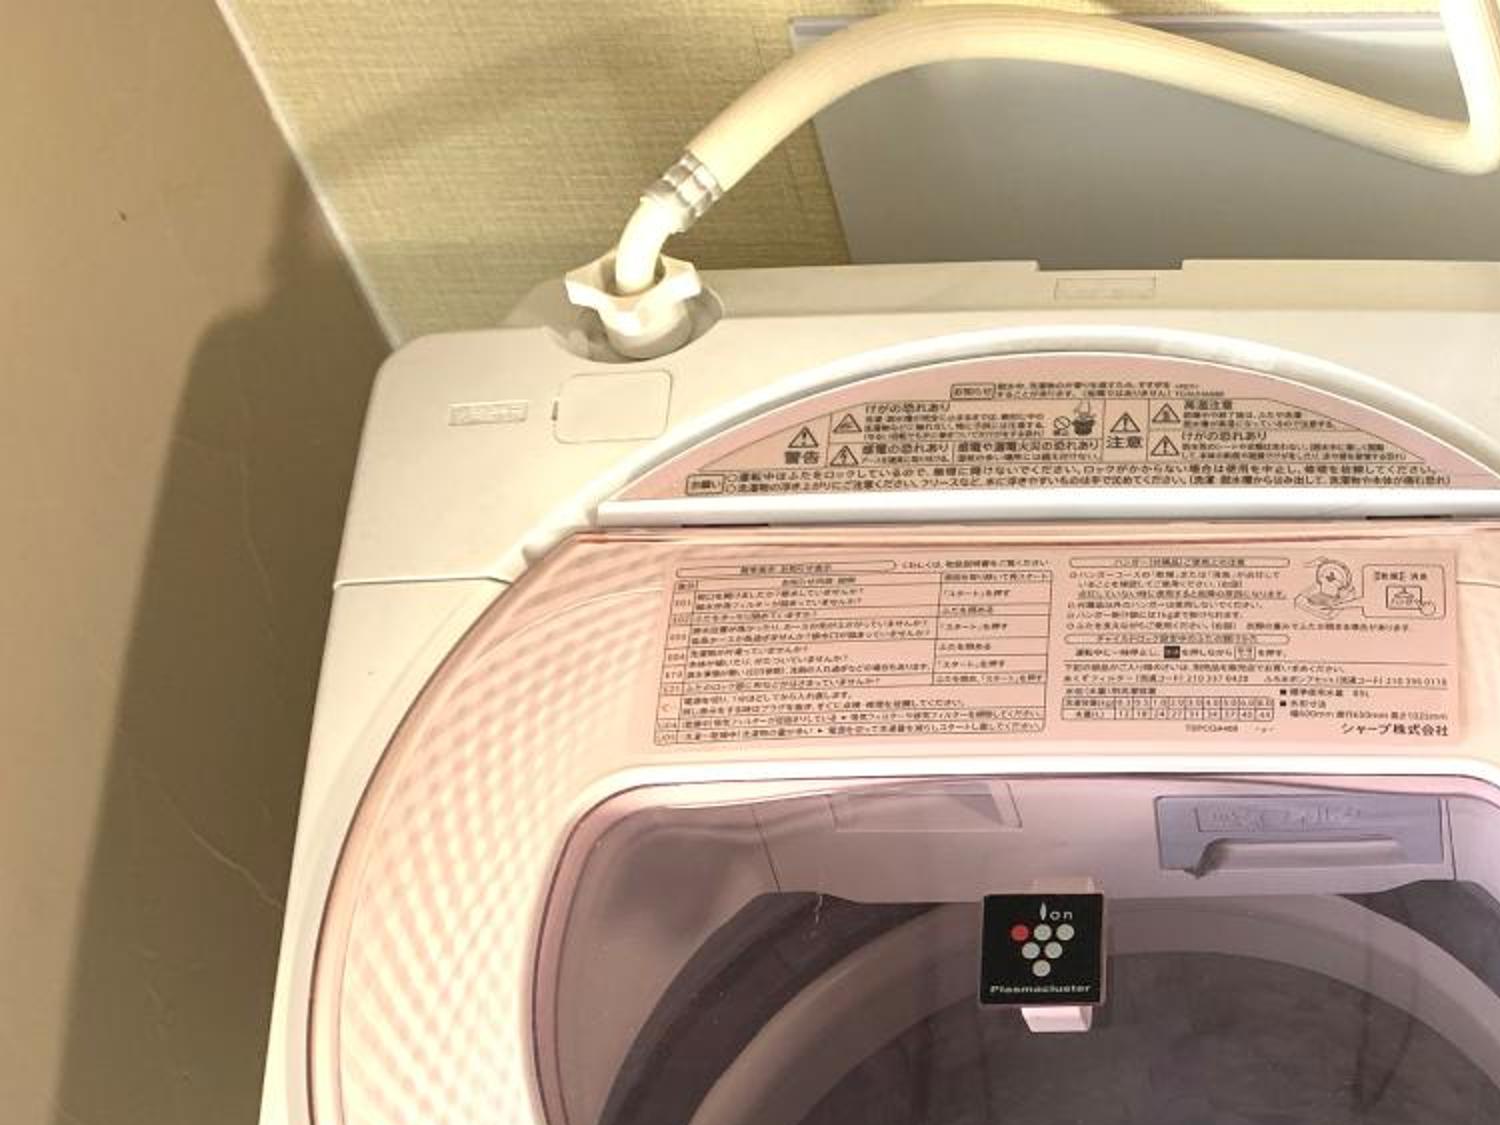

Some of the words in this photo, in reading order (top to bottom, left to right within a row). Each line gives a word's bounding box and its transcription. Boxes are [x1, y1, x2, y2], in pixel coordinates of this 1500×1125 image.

[1106, 436, 1143, 449] 注意
[1342, 722, 1449, 737] シャープ株式会社
[989, 985, 1092, 993] Plasmacluster
